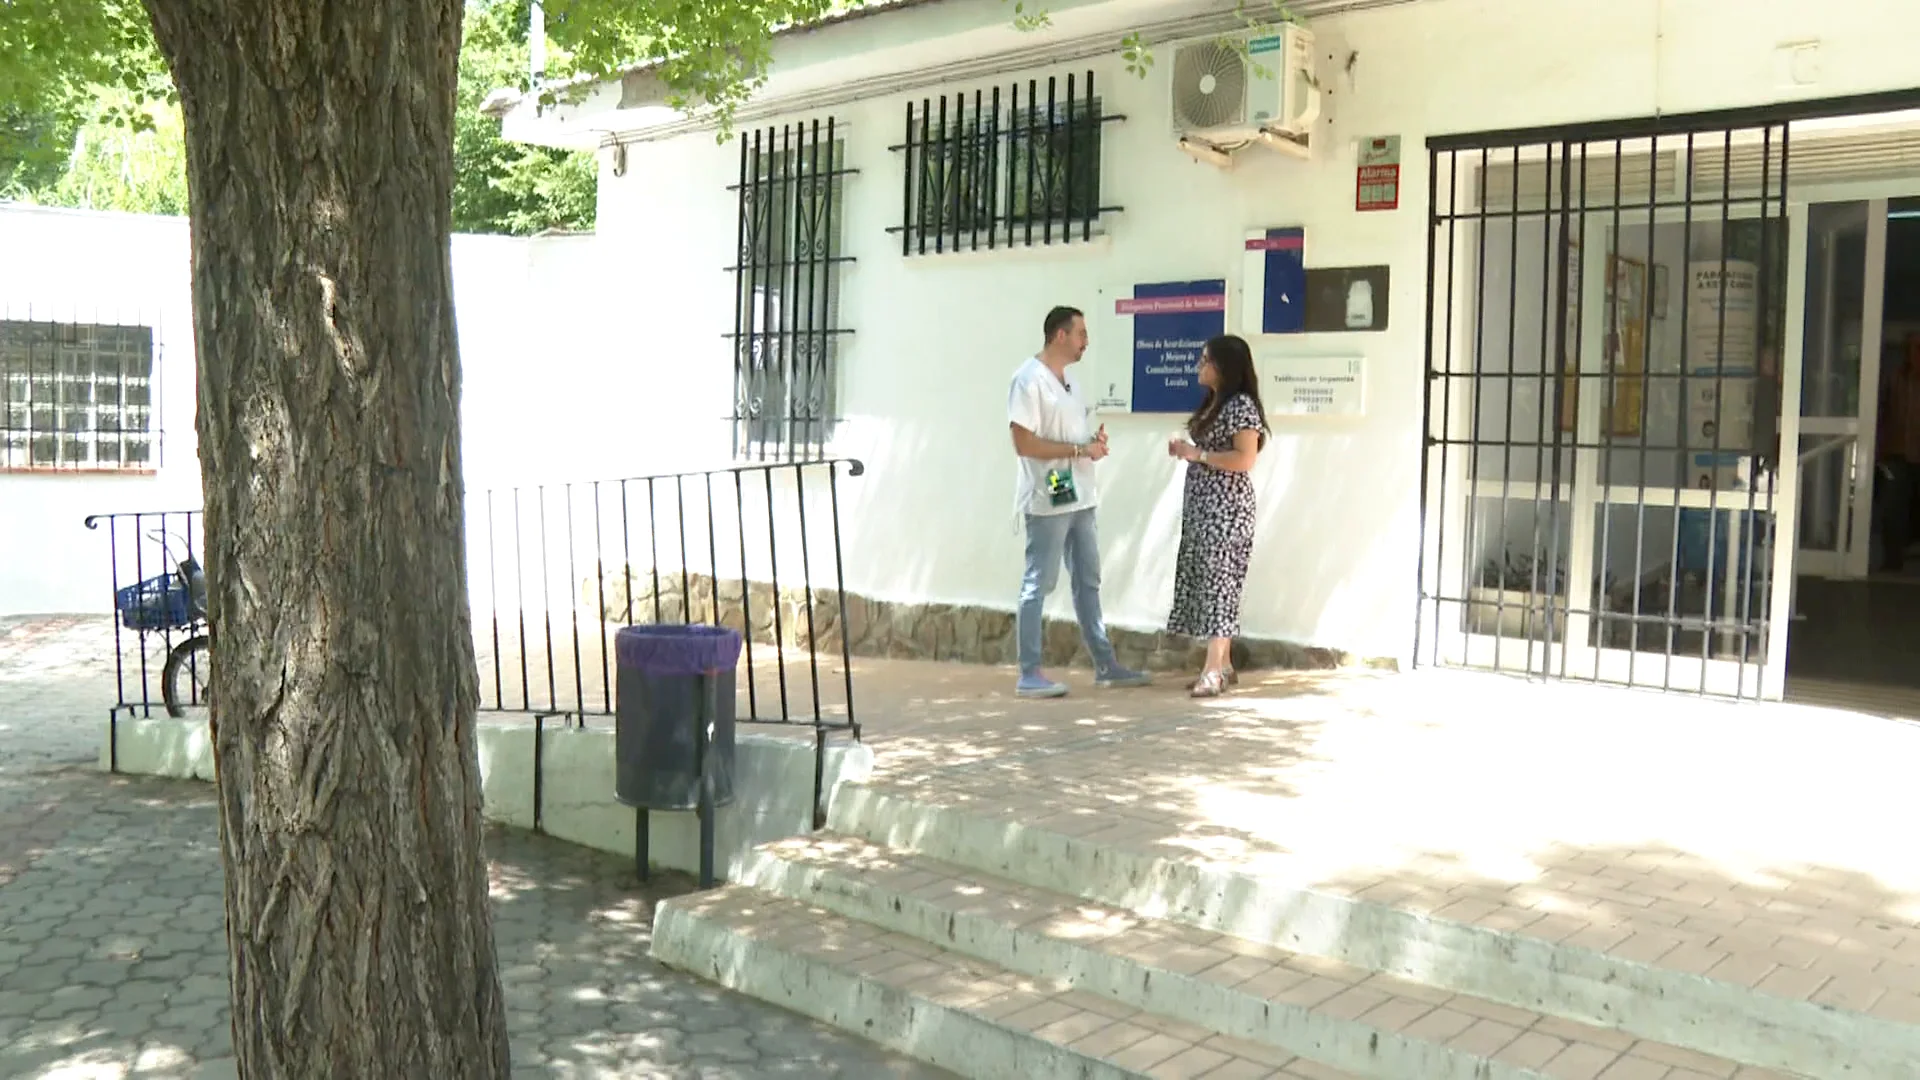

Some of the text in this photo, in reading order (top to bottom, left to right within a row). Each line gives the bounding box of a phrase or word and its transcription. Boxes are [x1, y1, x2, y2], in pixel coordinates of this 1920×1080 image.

[1360, 167, 1396, 178] Alarma
[1155, 340, 1162, 349] de
[1188, 352, 1195, 361] de
[1165, 377, 1188, 387] Locales
